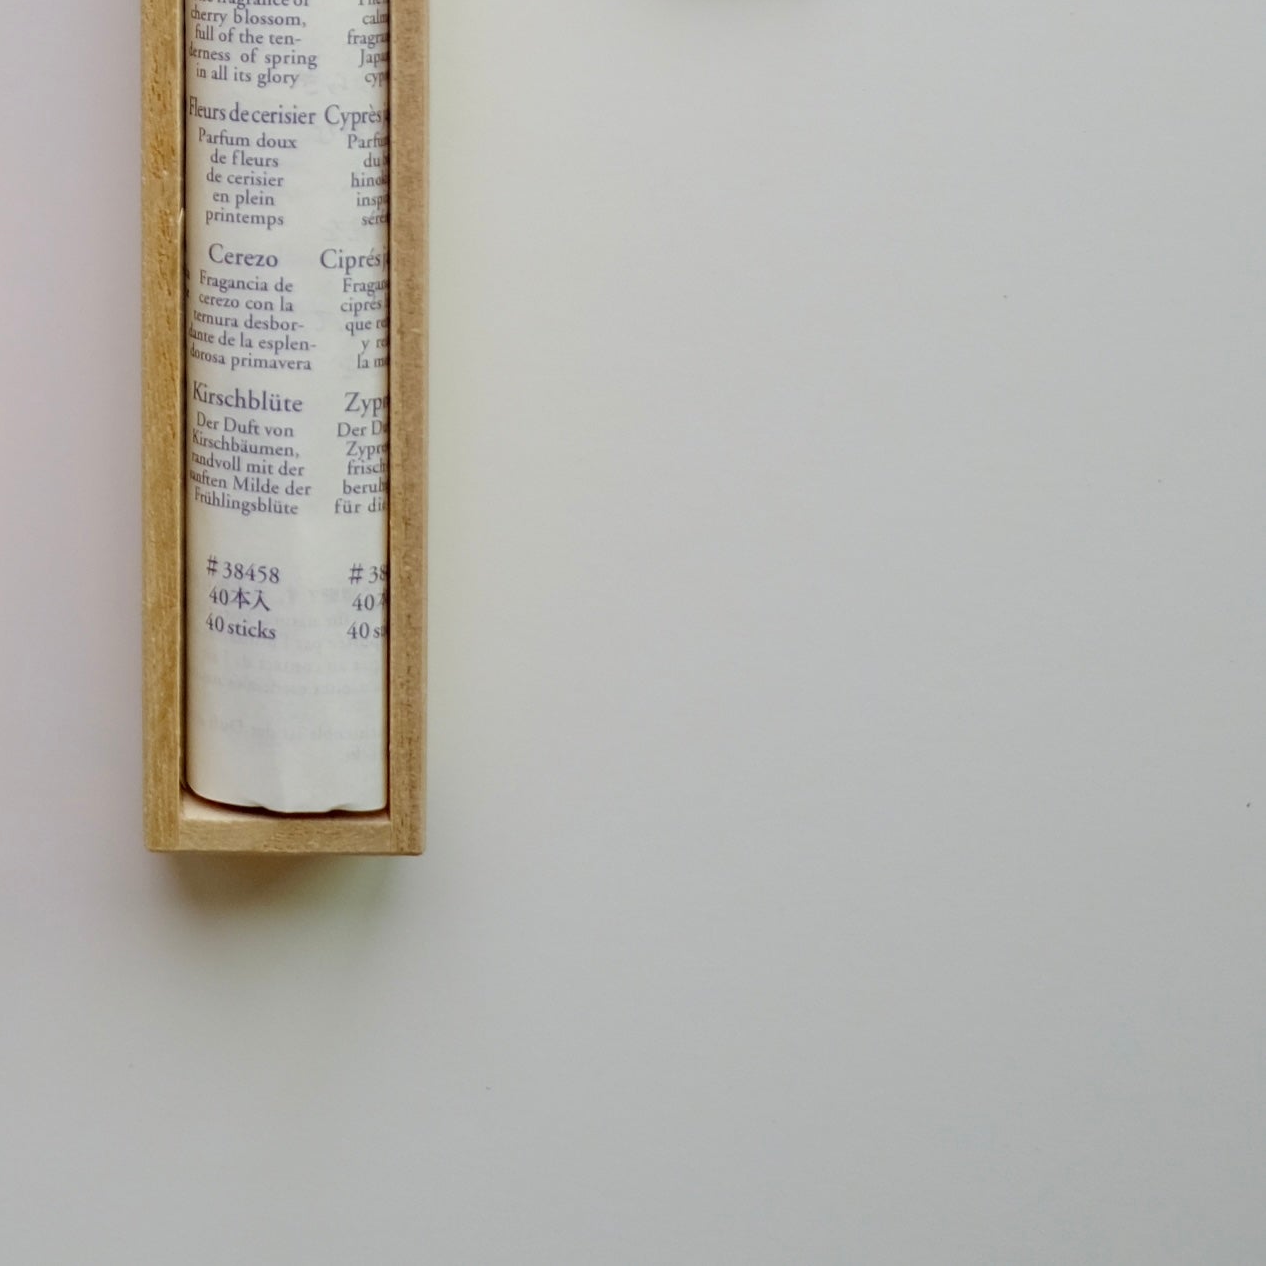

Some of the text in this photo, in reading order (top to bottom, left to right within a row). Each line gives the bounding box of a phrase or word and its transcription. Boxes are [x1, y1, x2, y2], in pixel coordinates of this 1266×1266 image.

[190, 4, 306, 27] cherry blossom,
[195, 24, 302, 45] full of the ten-
[240, 48, 258, 63] of
[264, 50, 318, 70] spring
[196, 62, 299, 88] in all its glory
[189, 95, 316, 125] Fleurs de cerisier
[324, 102, 382, 131] Cyprès
[198, 127, 298, 149] Parfum doux
[210, 148, 279, 167] de fleurs
[363, 152, 380, 168] du
[206, 167, 284, 187] de cerisier
[212, 189, 275, 209] en plein
[205, 207, 284, 230] printemps
[209, 243, 278, 268] Cerezo
[320, 247, 381, 275] Ciprés
[199, 269, 267, 293] Fragancia
[274, 277, 293, 292] de
[199, 293, 240, 310] cerezo
[245, 300, 274, 311] con
[280, 296, 294, 311] la
[340, 296, 382, 316] ciprés
[193, 310, 305, 331] ternura desbor-
[345, 320, 372, 336] que
[218, 331, 235, 346] de
[240, 332, 253, 348] la
[259, 335, 316, 354] esplen-
[361, 339, 370, 355] y
[190, 342, 311, 371] dorosa primavera
[357, 354, 370, 369] la
[192, 380, 303, 412] Kirschblüte
[196, 411, 294, 437] Der Duft von
[336, 421, 367, 438] Der
[192, 428, 299, 458] Kirschbäumen,
[192, 450, 304, 476] randvoll mit der
[234, 475, 279, 494] Milde
[284, 480, 311, 496] der
[194, 486, 299, 516] Frühlingsblüte
[334, 498, 362, 514] für
[209, 586, 270, 612] 40本入
[205, 614, 277, 640] 40 sticks
[346, 621, 370, 640] 40
